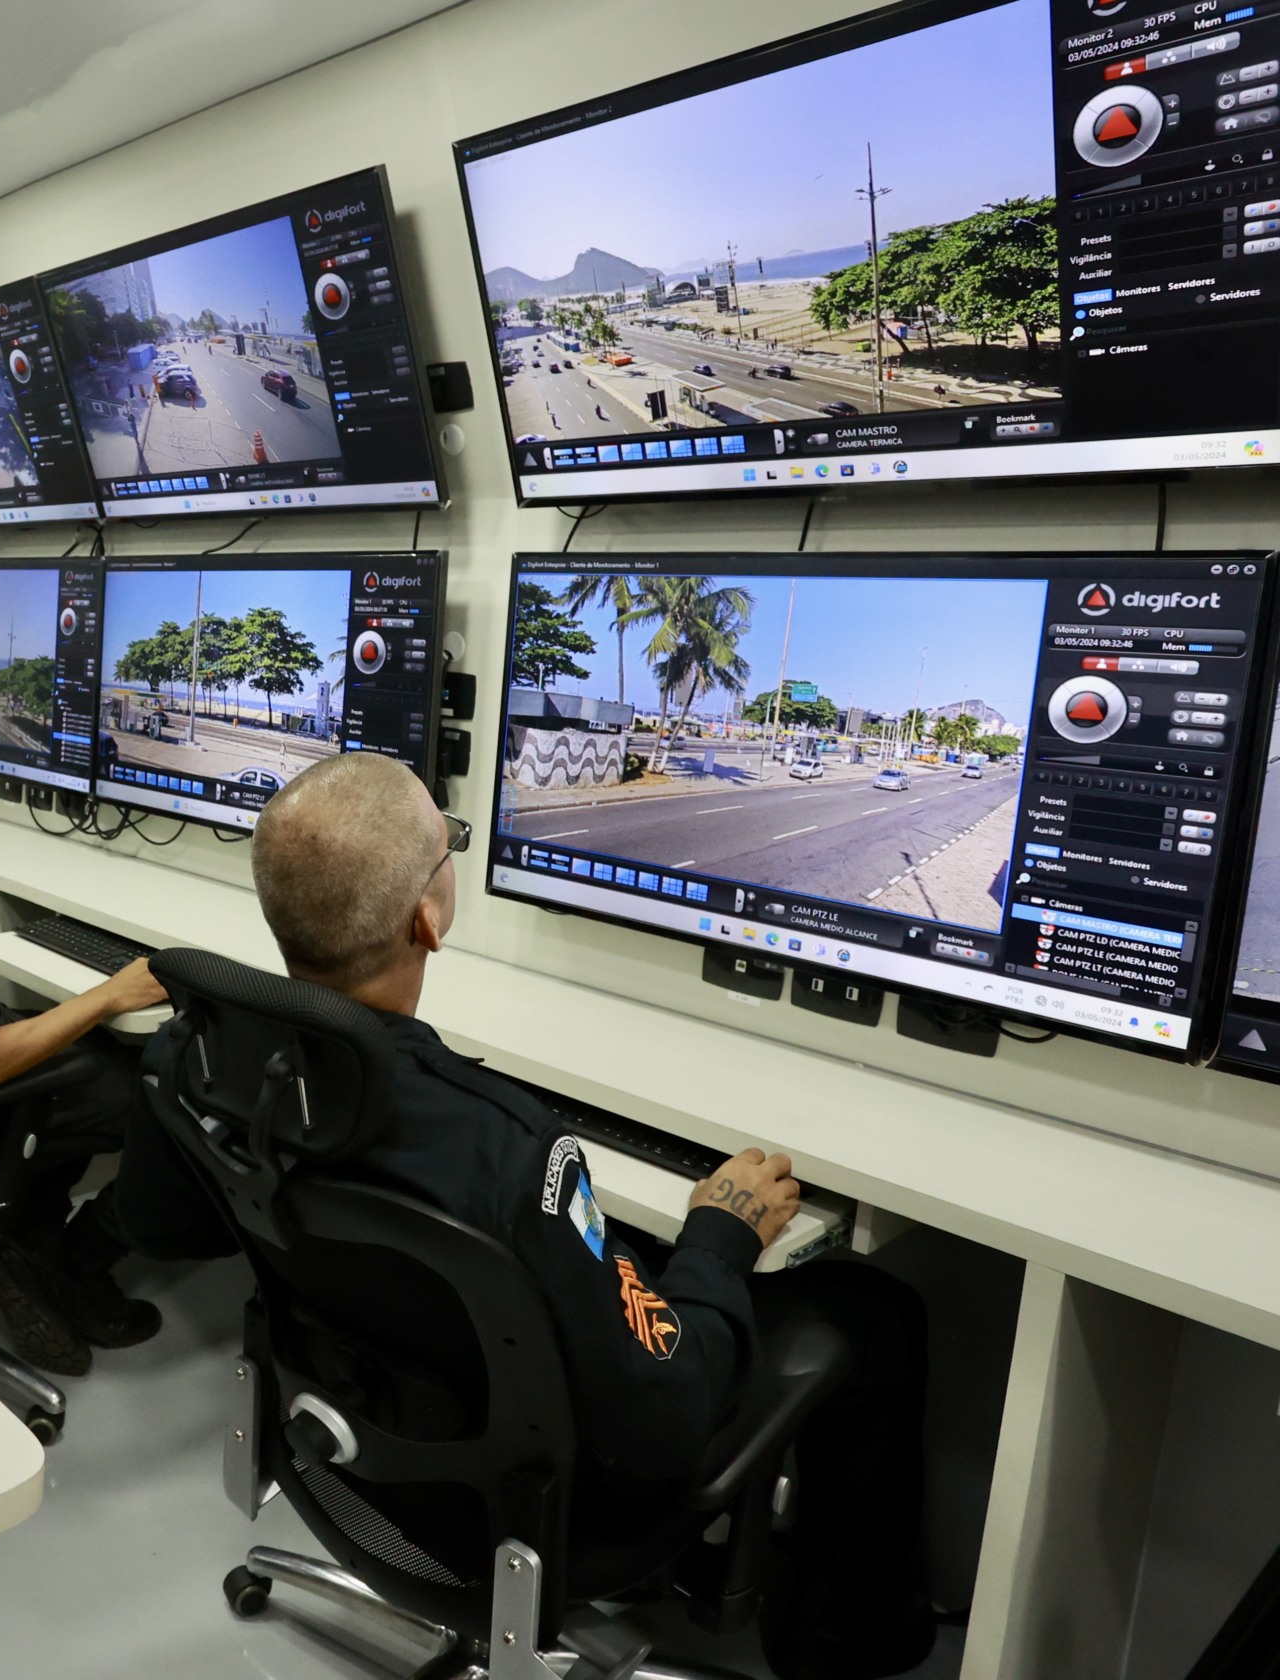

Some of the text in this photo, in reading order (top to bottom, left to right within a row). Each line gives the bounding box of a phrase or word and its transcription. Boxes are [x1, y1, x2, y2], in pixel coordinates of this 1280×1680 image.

[1194, 0, 1217, 15] CPU
[1144, 12, 1176, 28] 30 FPS
[1194, 17, 1221, 30] Mem
[1068, 29, 1113, 48] Monitor 2
[1068, 31, 1160, 62] 03/05/2024 09:32:46
[324, 201, 366, 221] digifort
[1081, 234, 1112, 246] Presets
[1070, 251, 1112, 266] Vigilância
[1079, 268, 1113, 280] Auxiliar
[1116, 285, 1161, 298] Monitores
[1168, 277, 1215, 290] Servidores
[1210, 288, 1261, 302] Servidores
[1089, 306, 1123, 318] Objetos
[1109, 344, 1148, 355] Câmeras
[996, 413, 1036, 424] Bookmark
[835, 425, 898, 438] CAM MASTRO
[837, 437, 903, 450] CAMERA TERMICA
[1173, 452, 1227, 461] 03/05/2024
[382, 576, 422, 589] digifort
[1121, 591, 1221, 613] digifort
[1056, 626, 1089, 635] Monitor
[1121, 628, 1149, 637] 30 FPS
[1164, 630, 1184, 638] CPU
[1054, 637, 1133, 648] 03/05/2024 09:32:46
[1162, 643, 1185, 651] Mem
[1040, 795, 1067, 806] Presets
[1028, 810, 1065, 822] Vigilância
[1033, 825, 1063, 837] Auxiliar
[1036, 860, 1067, 873] Objetos
[1063, 850, 1103, 863] Monitores
[1108, 856, 1150, 870] Servidores
[1143, 877, 1188, 892] Servidores
[1049, 898, 1083, 912] Câmeras
[792, 905, 838, 922] CAM PTZ LE
[790, 916, 878, 941] CAMERA MEDIO ALCANCE
[1059, 915, 1080, 925] CAM
[1081, 918, 1117, 933] MASTRO
[938, 933, 974, 947] Bookmark
[1058, 929, 1079, 939] CAM
[1080, 933, 1095, 942] PTZ
[1097, 936, 1108, 945] LD
[1109, 938, 1150, 954] (CAMERA
[1056, 942, 1178, 973] CAM PTZ LE (CAMERA MEDIO
[1054, 956, 1175, 988] CAM PTZ LT (CAMERA MEDIO
